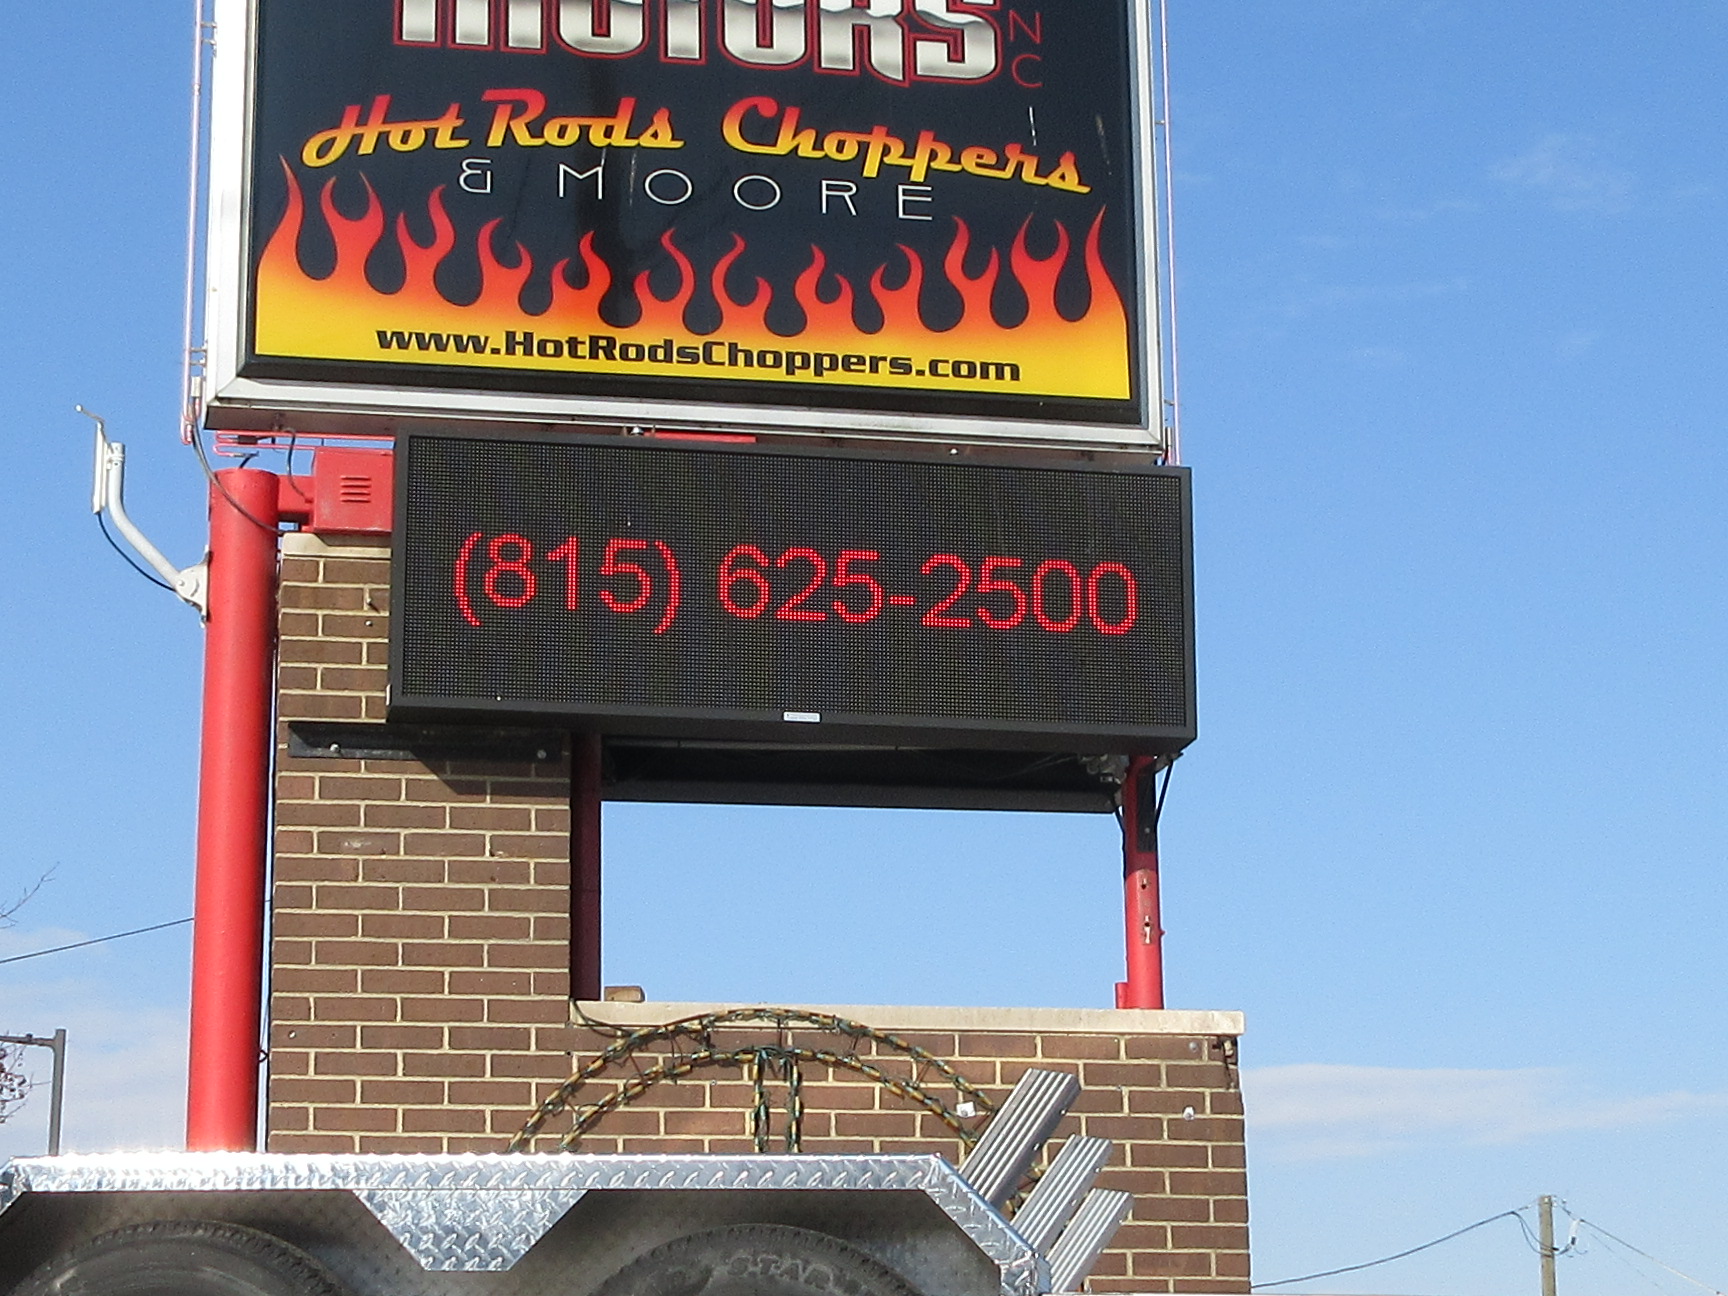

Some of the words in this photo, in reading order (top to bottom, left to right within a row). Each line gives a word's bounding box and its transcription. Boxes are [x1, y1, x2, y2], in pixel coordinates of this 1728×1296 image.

[302, 94, 470, 168] Hot
[480, 88, 684, 149] Rods
[721, 95, 1091, 194] Choppers
[457, 157, 493, 195] &
[558, 163, 934, 222] MOORE
[375, 325, 1022, 384] www.HotRodsChoppers.com
[453, 532, 682, 635] (815)
[717, 544, 1139, 637] 625-2500
